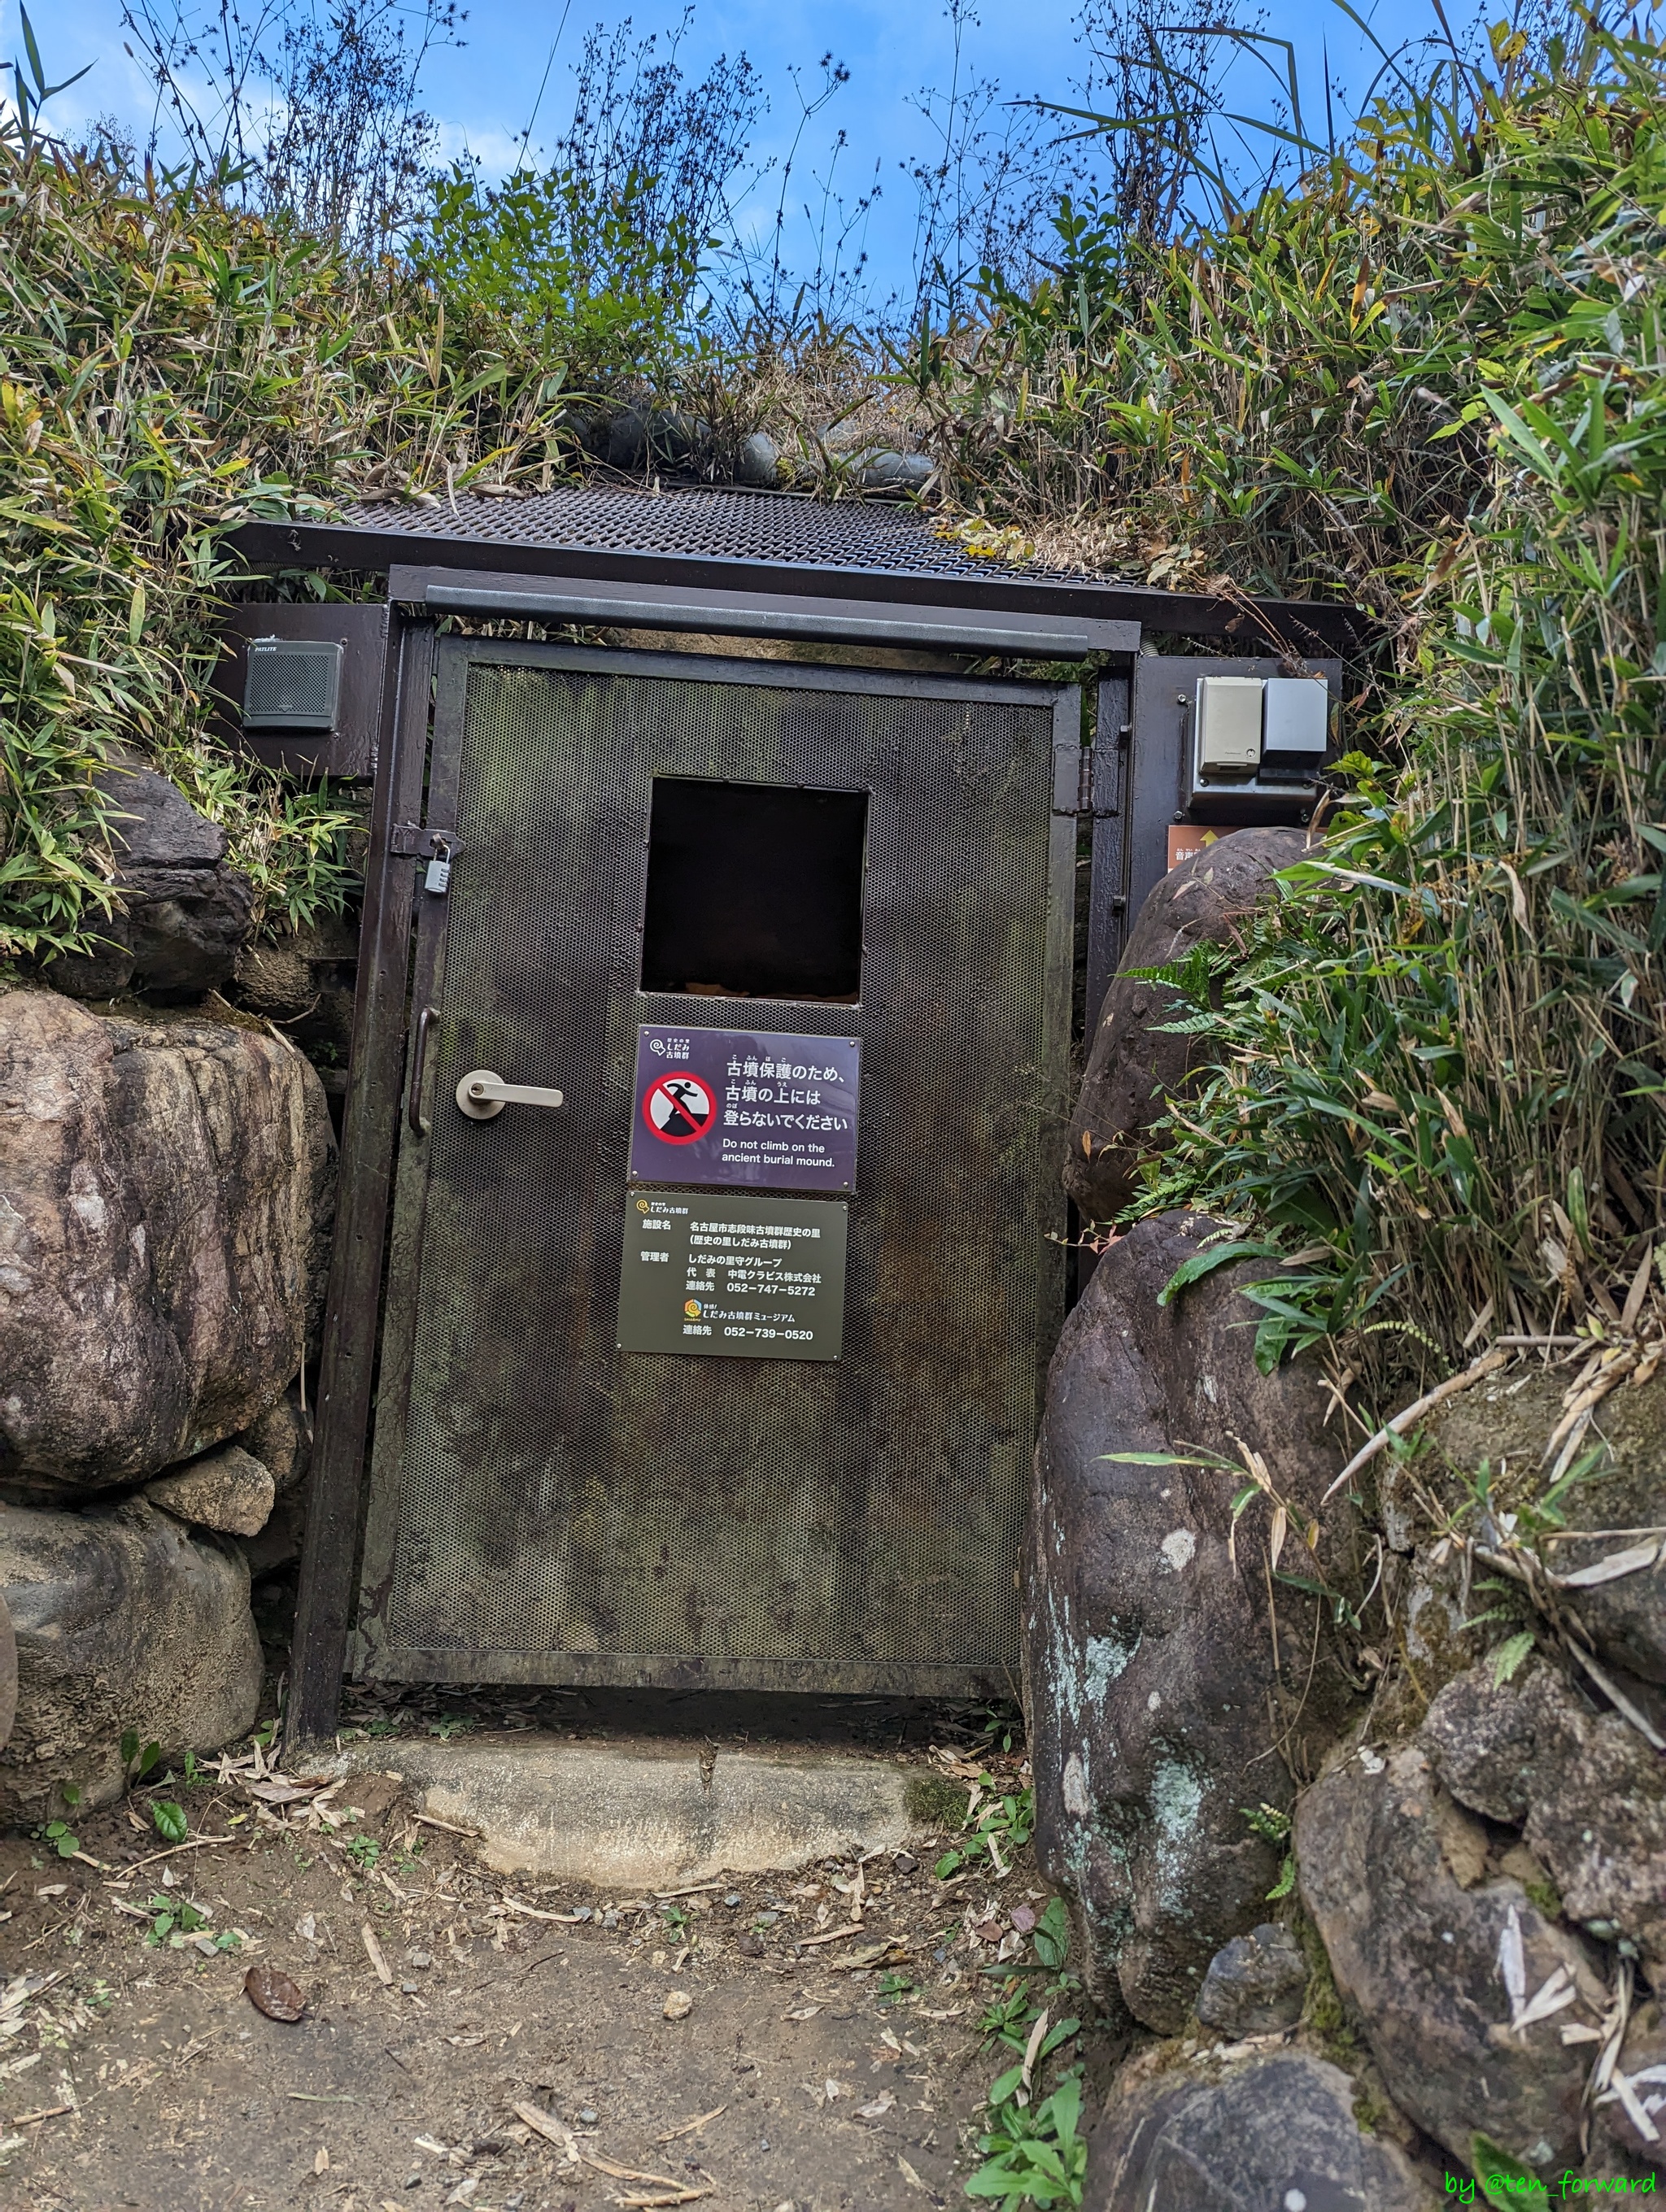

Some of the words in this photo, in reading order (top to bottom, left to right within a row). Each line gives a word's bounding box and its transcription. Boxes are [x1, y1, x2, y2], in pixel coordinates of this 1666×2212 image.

[666, 1051, 690, 1060] 古墳群
[667, 1043, 690, 1052] しだみ
[726, 1060, 845, 1083] 古墳保護のため、
[725, 1084, 822, 1105] 古墳の上には
[723, 1109, 848, 1131] 登らないでください
[722, 1139, 738, 1148] Do
[739, 1141, 758, 1150] not
[761, 1141, 789, 1152] climb
[792, 1144, 805, 1152] on
[807, 1143, 825, 1153] the
[722, 1153, 761, 1164] ancient
[763, 1154, 794, 1165] burial
[796, 1157, 835, 1168] mound.
[651, 1206, 689, 1215] しだみ古墳群
[642, 1218, 672, 1230] 施設名
[689, 1221, 821, 1239] 名古屋市志段味古墳群歴史の里
[640, 1251, 669, 1263] 管理者
[688, 1254, 783, 1268] しだみの里守グループ
[686, 1267, 697, 1278] 代
[705, 1268, 717, 1278] 表
[727, 1269, 822, 1284] 中電クラビス株式会社
[685, 1280, 715, 1291] 連絡先
[726, 1282, 816, 1296] 052-747-5272
[702, 1309, 796, 1323] しだみ古墳群ミュージアム
[683, 1324, 713, 1336] 連絡先
[723, 1326, 813, 1341] 052-739-0520
